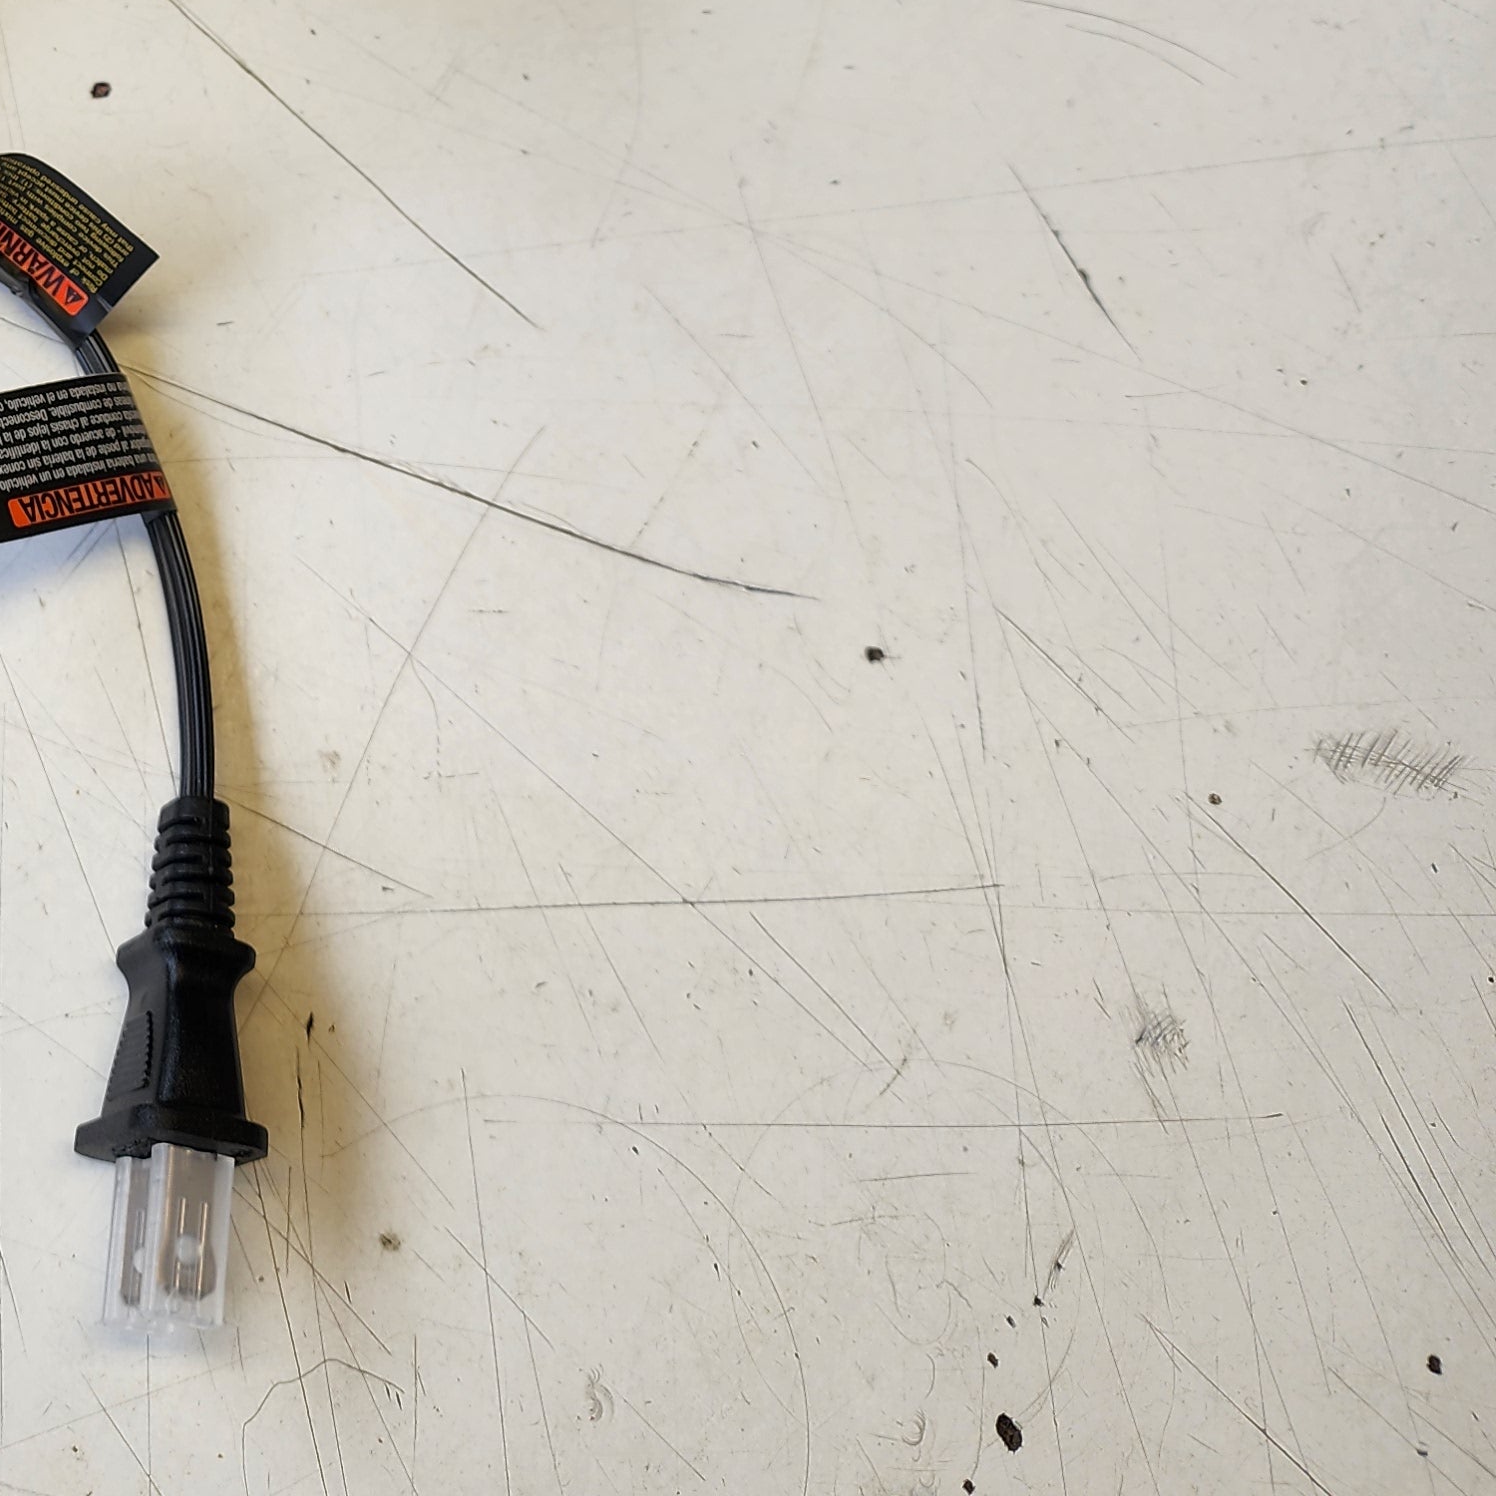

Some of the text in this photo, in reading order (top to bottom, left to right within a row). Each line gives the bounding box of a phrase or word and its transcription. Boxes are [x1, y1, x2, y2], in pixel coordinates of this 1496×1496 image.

[67, 265, 81, 278] of
[45, 390, 56, 404] el
[55, 388, 68, 400] en
[68, 381, 107, 401] instalada
[101, 396, 113, 410] de
[48, 417, 80, 434] chasis
[79, 415, 90, 429] al
[12, 427, 27, 442] de
[25, 420, 50, 439] lejos
[103, 426, 117, 440] de
[1, 430, 14, 444] la
[50, 435, 69, 449] con
[68, 427, 105, 447] acuerdo
[40, 438, 52, 453] la
[84, 445, 97, 459] de
[95, 439, 121, 456] poste
[74, 448, 85, 462] la
[25, 456, 42, 472] sin
[65, 458, 106, 479] instalada
[38, 470, 52, 482] un
[51, 467, 65, 479] en
[16, 472, 156, 524] ADVERTENCIA
